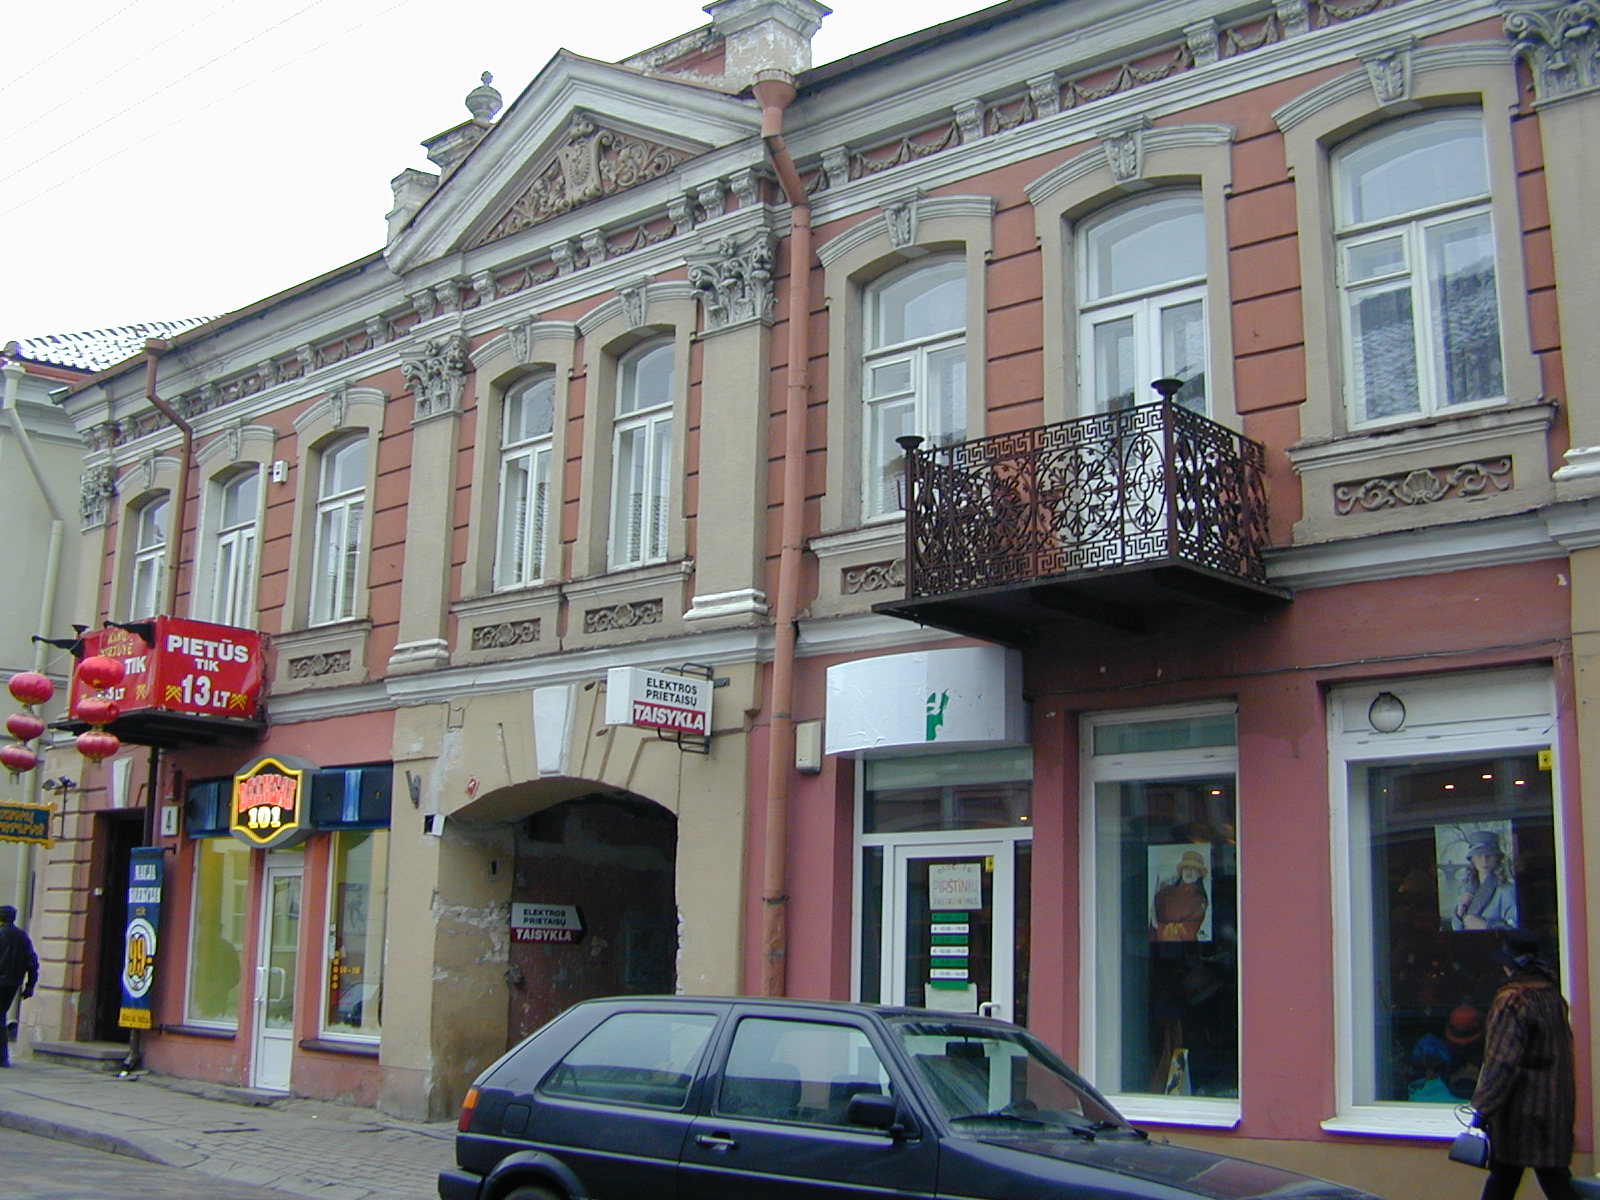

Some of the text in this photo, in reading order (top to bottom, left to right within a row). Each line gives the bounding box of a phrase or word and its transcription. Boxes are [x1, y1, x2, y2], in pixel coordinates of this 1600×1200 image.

[167, 634, 249, 663] PIETŪS
[125, 656, 147, 675] TIK
[195, 658, 220, 672] TIK
[181, 674, 231, 708] 13 LT
[646, 677, 697, 695] ELEKTROS
[645, 689, 697, 708] PRIETAISŲ
[634, 704, 705, 730] TAISYKLA
[247, 806, 281, 829] 101
[523, 908, 566, 917] ELEKTROS
[516, 928, 572, 942] TAISYKLA
